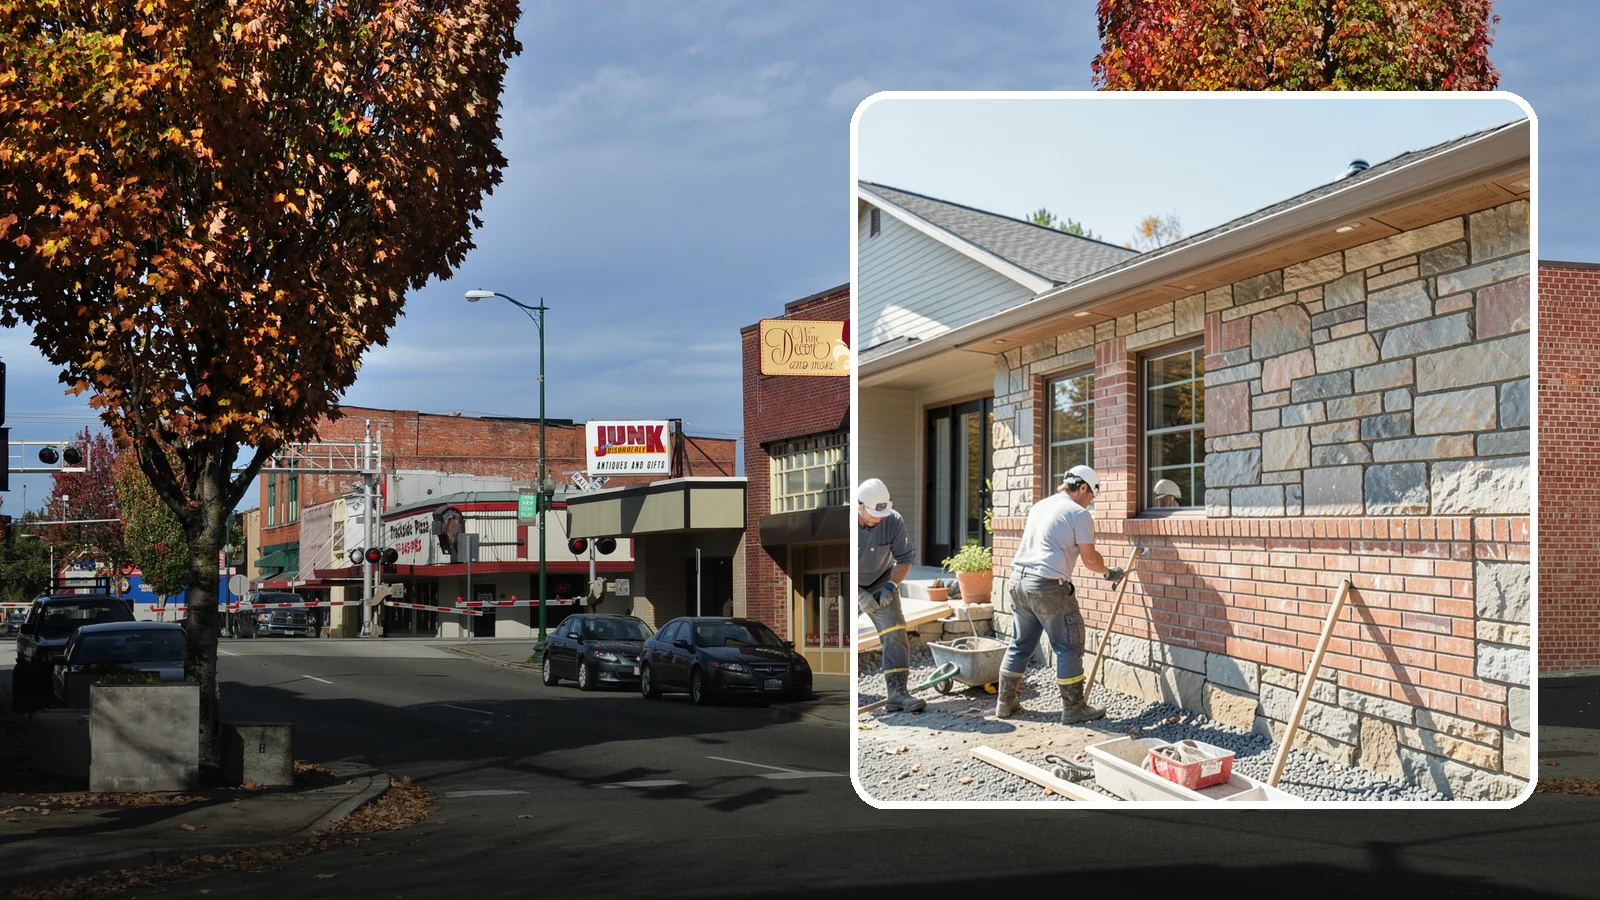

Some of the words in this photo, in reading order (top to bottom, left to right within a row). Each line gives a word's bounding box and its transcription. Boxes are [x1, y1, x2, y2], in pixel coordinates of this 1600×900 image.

[595, 425, 665, 457] JUNK
[607, 446, 646, 454] DISORDERLY
[597, 461, 628, 469] ANTIQUES
[631, 461, 644, 469] AND
[647, 460, 665, 469] GIFTS
[390, 521, 413, 540] Trackside
[415, 519, 429, 534] Pizza
